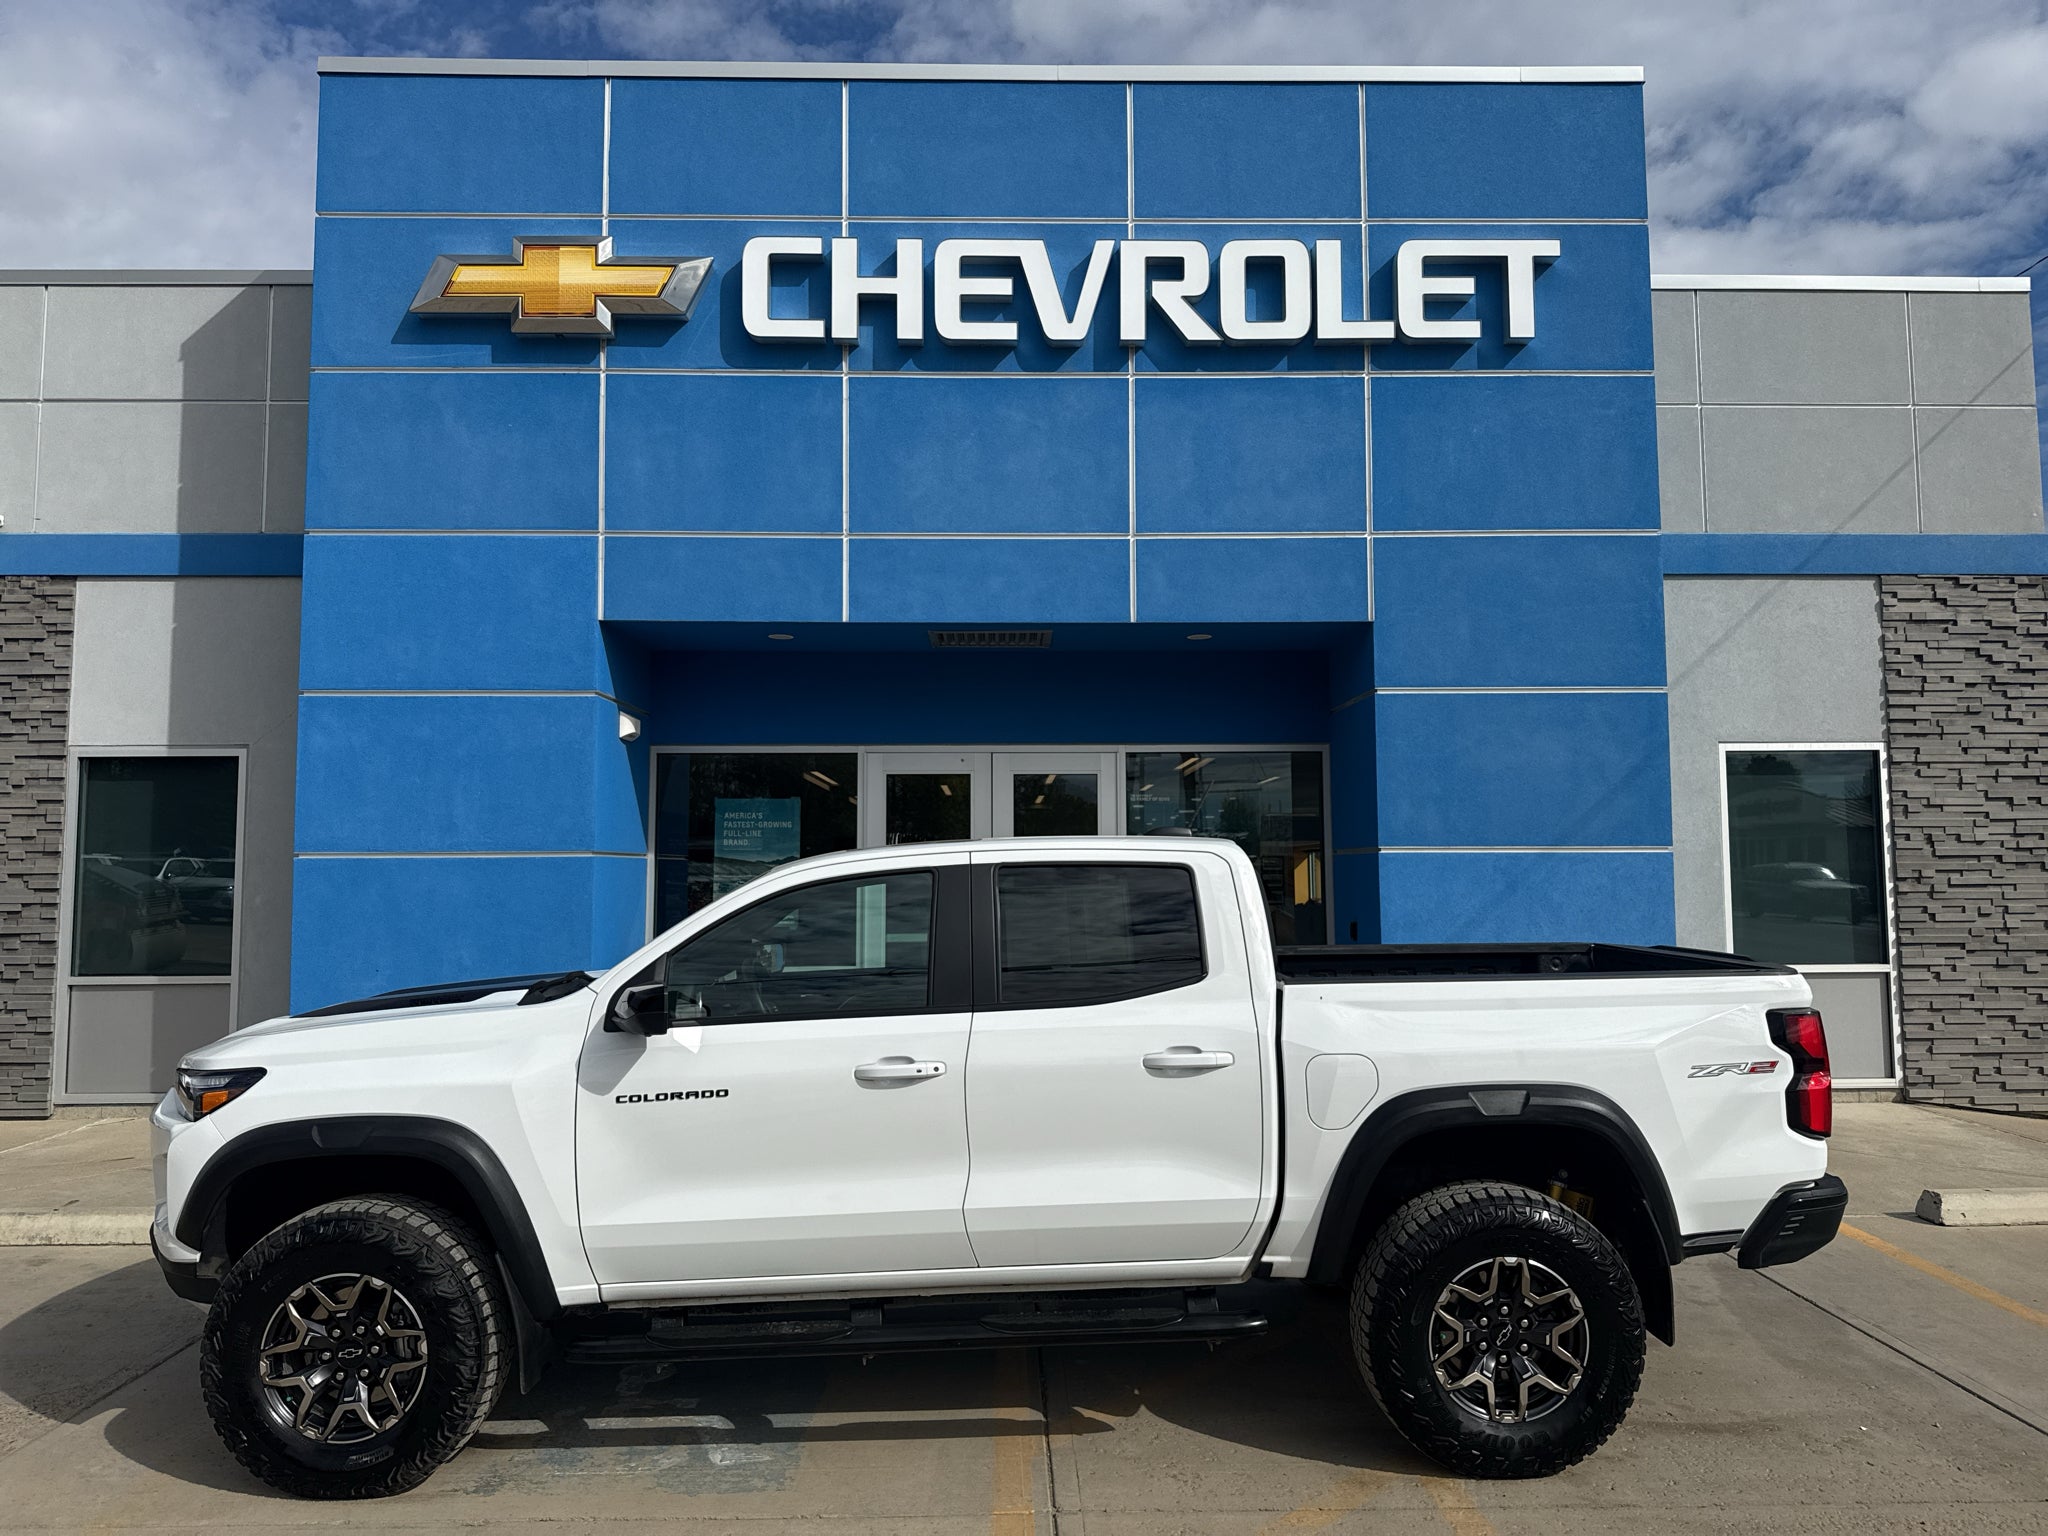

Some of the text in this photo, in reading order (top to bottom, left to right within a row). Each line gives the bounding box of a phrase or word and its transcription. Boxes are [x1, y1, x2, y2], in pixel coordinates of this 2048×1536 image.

[741, 236, 1562, 343] CHEVROLET
[723, 812, 763, 820] AMERICA'S
[723, 821, 793, 829] FASTEST-GROWING
[723, 829, 762, 838] FULL-LINE
[723, 838, 751, 846] BRAND.
[1687, 1060, 1780, 1079] ZR2
[615, 1088, 729, 1104] COLORADO
